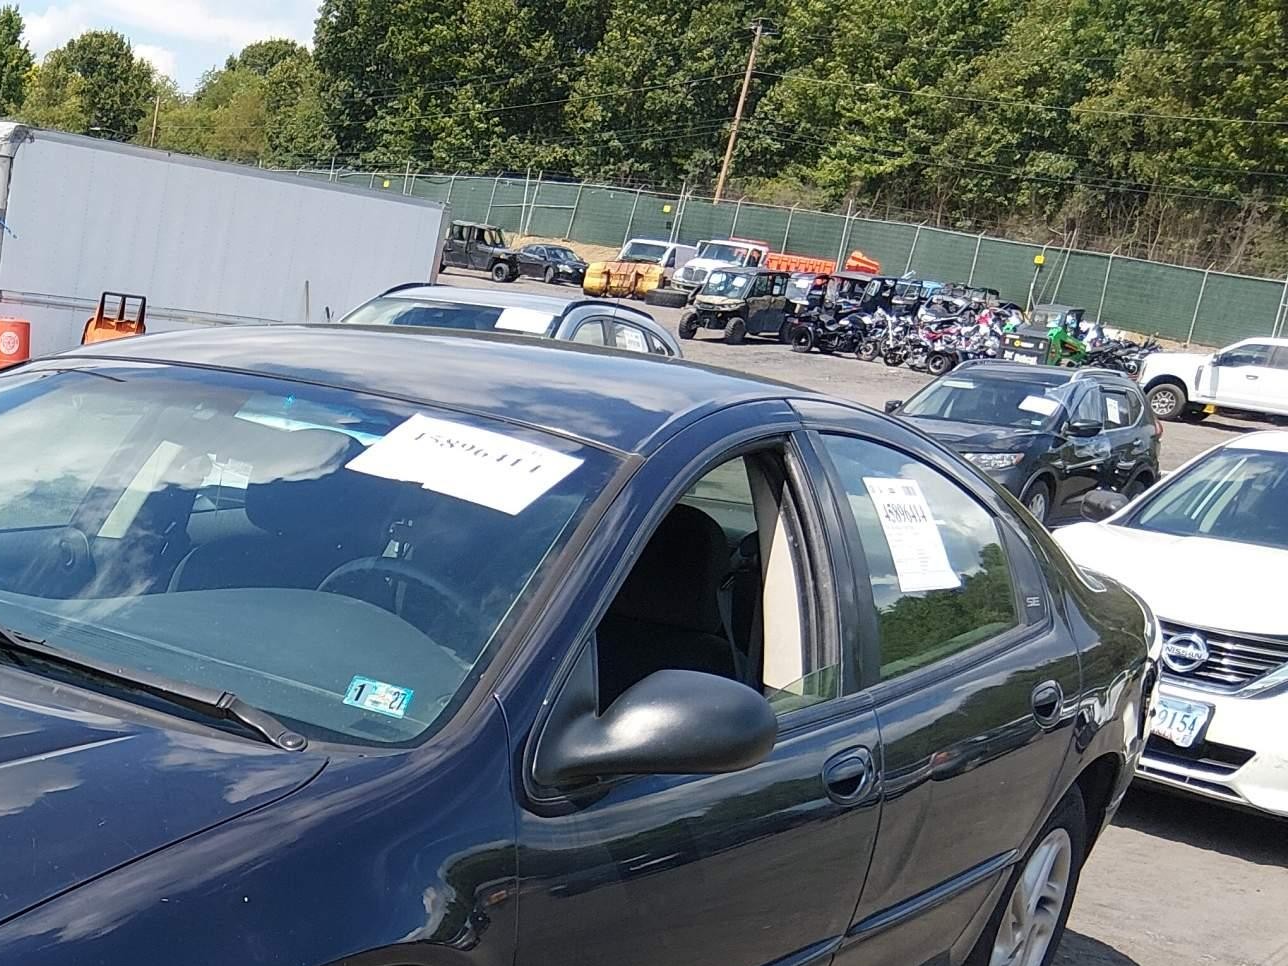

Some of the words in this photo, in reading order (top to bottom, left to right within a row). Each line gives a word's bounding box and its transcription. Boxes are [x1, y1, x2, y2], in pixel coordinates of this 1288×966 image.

[1026, 596, 1041, 608] SE
[1166, 645, 1202, 660] NISSAN
[353, 683, 367, 702] 1
